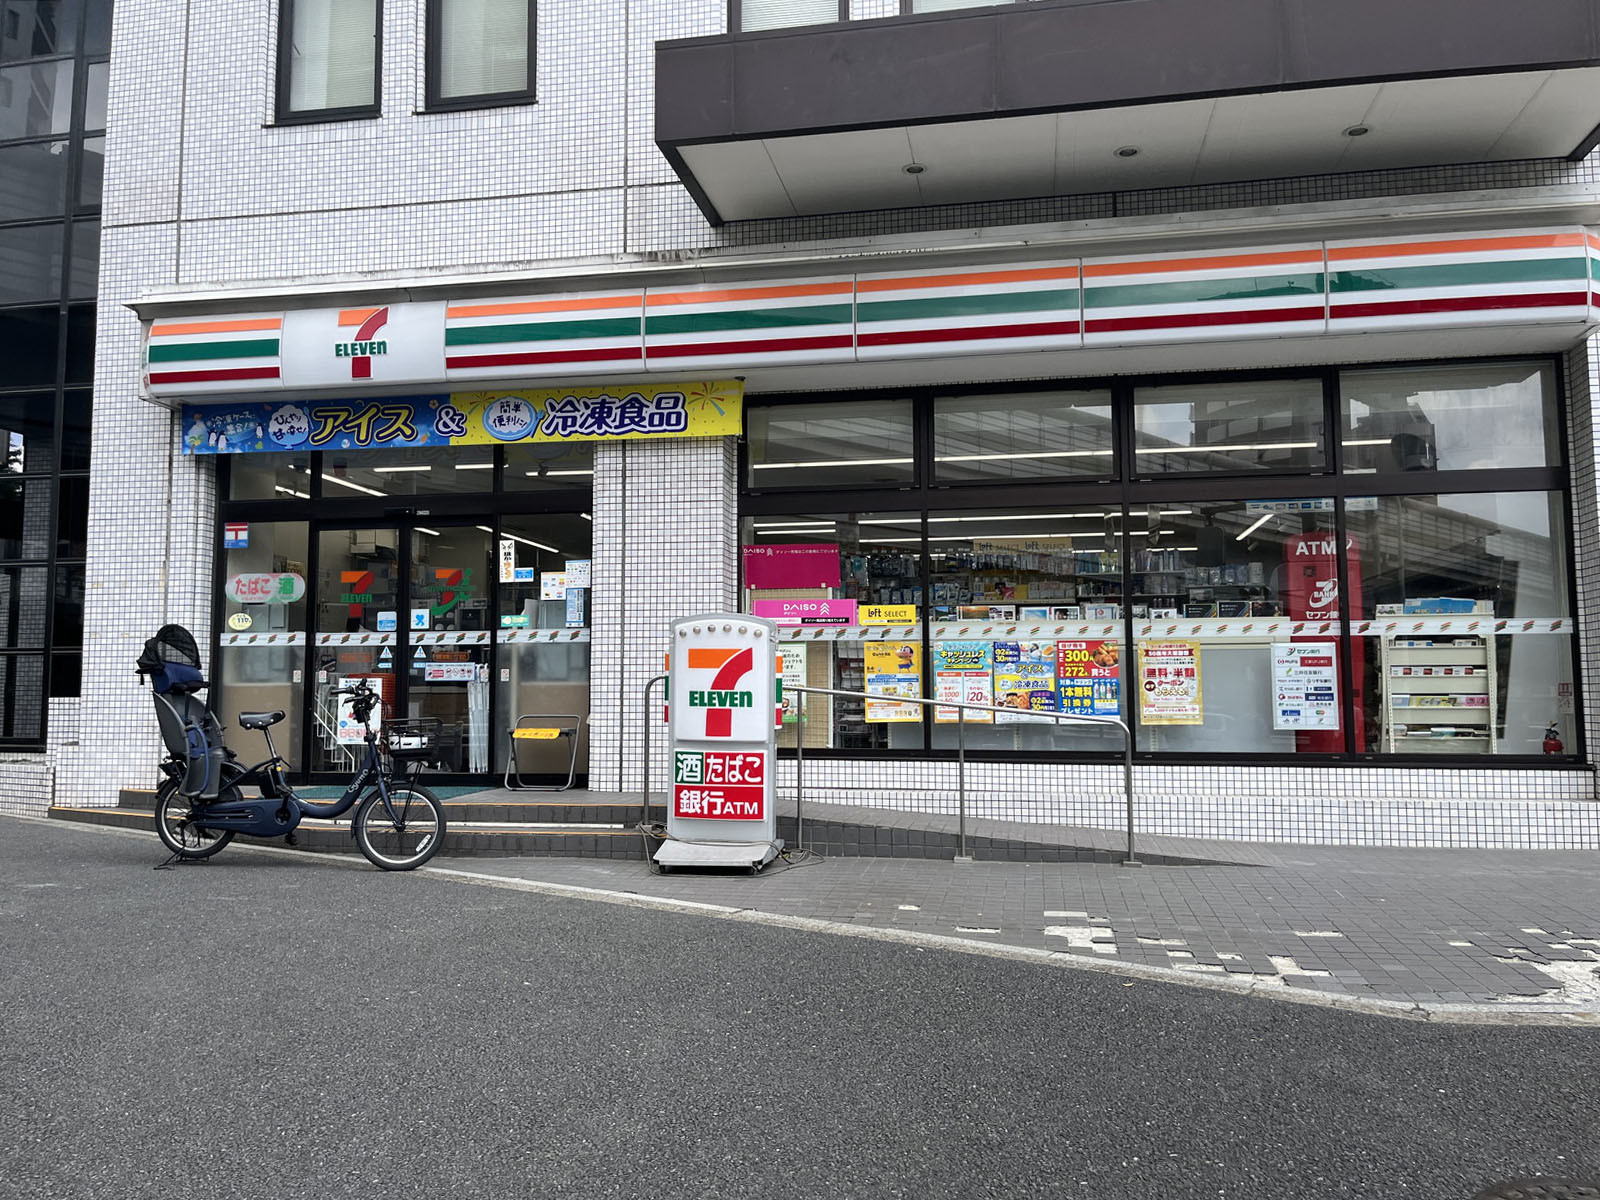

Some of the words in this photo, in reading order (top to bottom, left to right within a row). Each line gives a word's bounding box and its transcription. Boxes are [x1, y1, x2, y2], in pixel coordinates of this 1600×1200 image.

[500, 401, 522, 413] 簡単
[543, 393, 686, 434] 冷凍食品
[310, 402, 417, 445] アイス
[435, 404, 466, 436] &
[1296, 541, 1337, 555] ATM
[235, 577, 272, 595] たばこ
[783, 603, 817, 611] DAISO
[940, 650, 985, 658] キャッシュレス
[1016, 664, 1044, 674] アイス
[676, 753, 703, 785] 酒
[705, 754, 762, 784] たばこ
